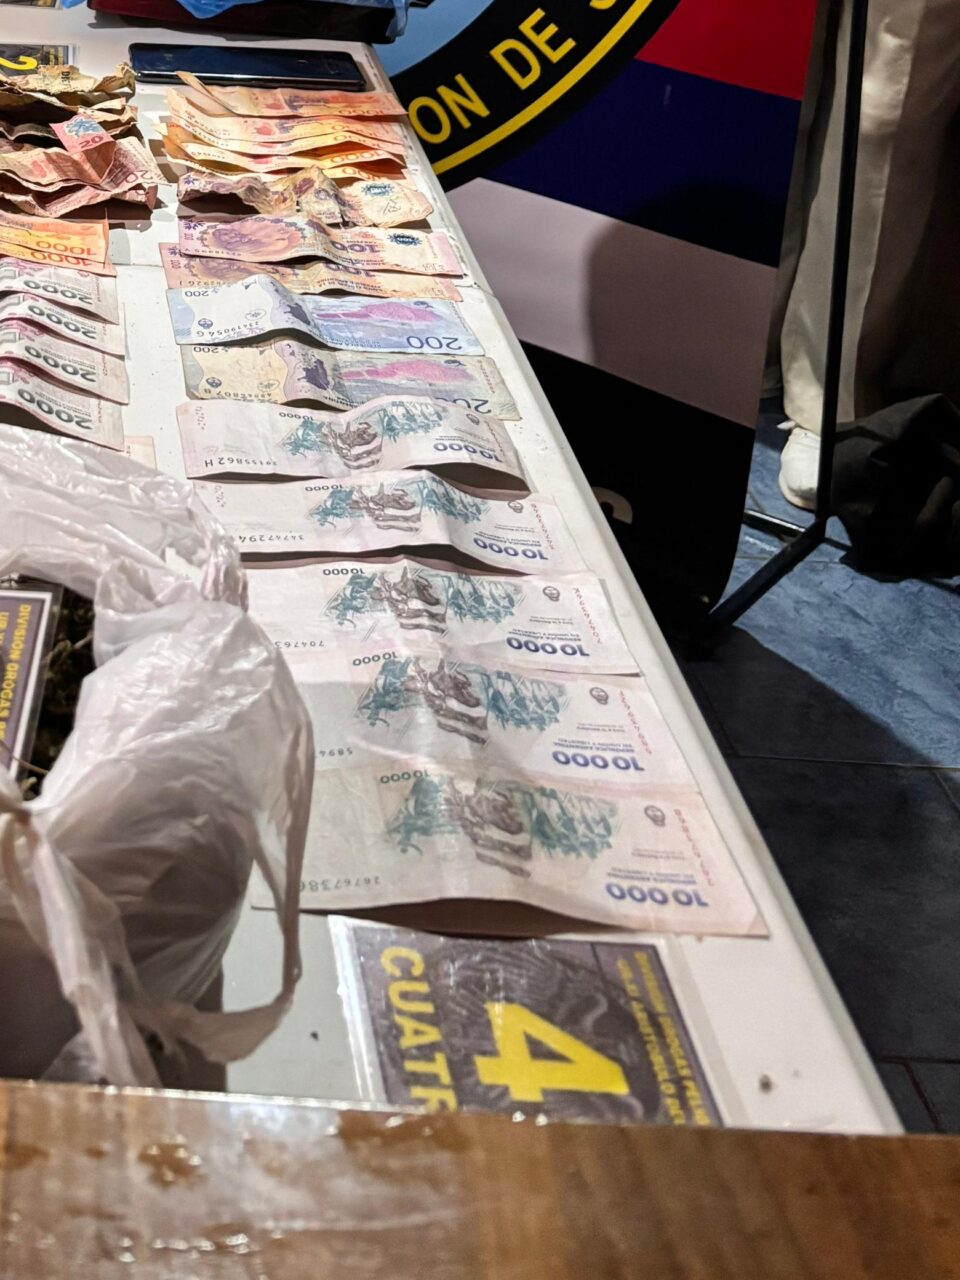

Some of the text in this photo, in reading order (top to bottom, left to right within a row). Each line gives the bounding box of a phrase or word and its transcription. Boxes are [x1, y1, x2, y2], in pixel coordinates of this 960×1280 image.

[408, 75, 489, 146] ON
[492, 8, 577, 91] DE
[23, 278, 93, 305] 2000
[28, 304, 97, 340] 2000
[407, 335, 463, 351] 200
[23, 345, 97, 383] 2000
[17, 387, 94, 431] 2000
[378, 945, 458, 1113] CUATR
[473, 1001, 631, 1103] 4
